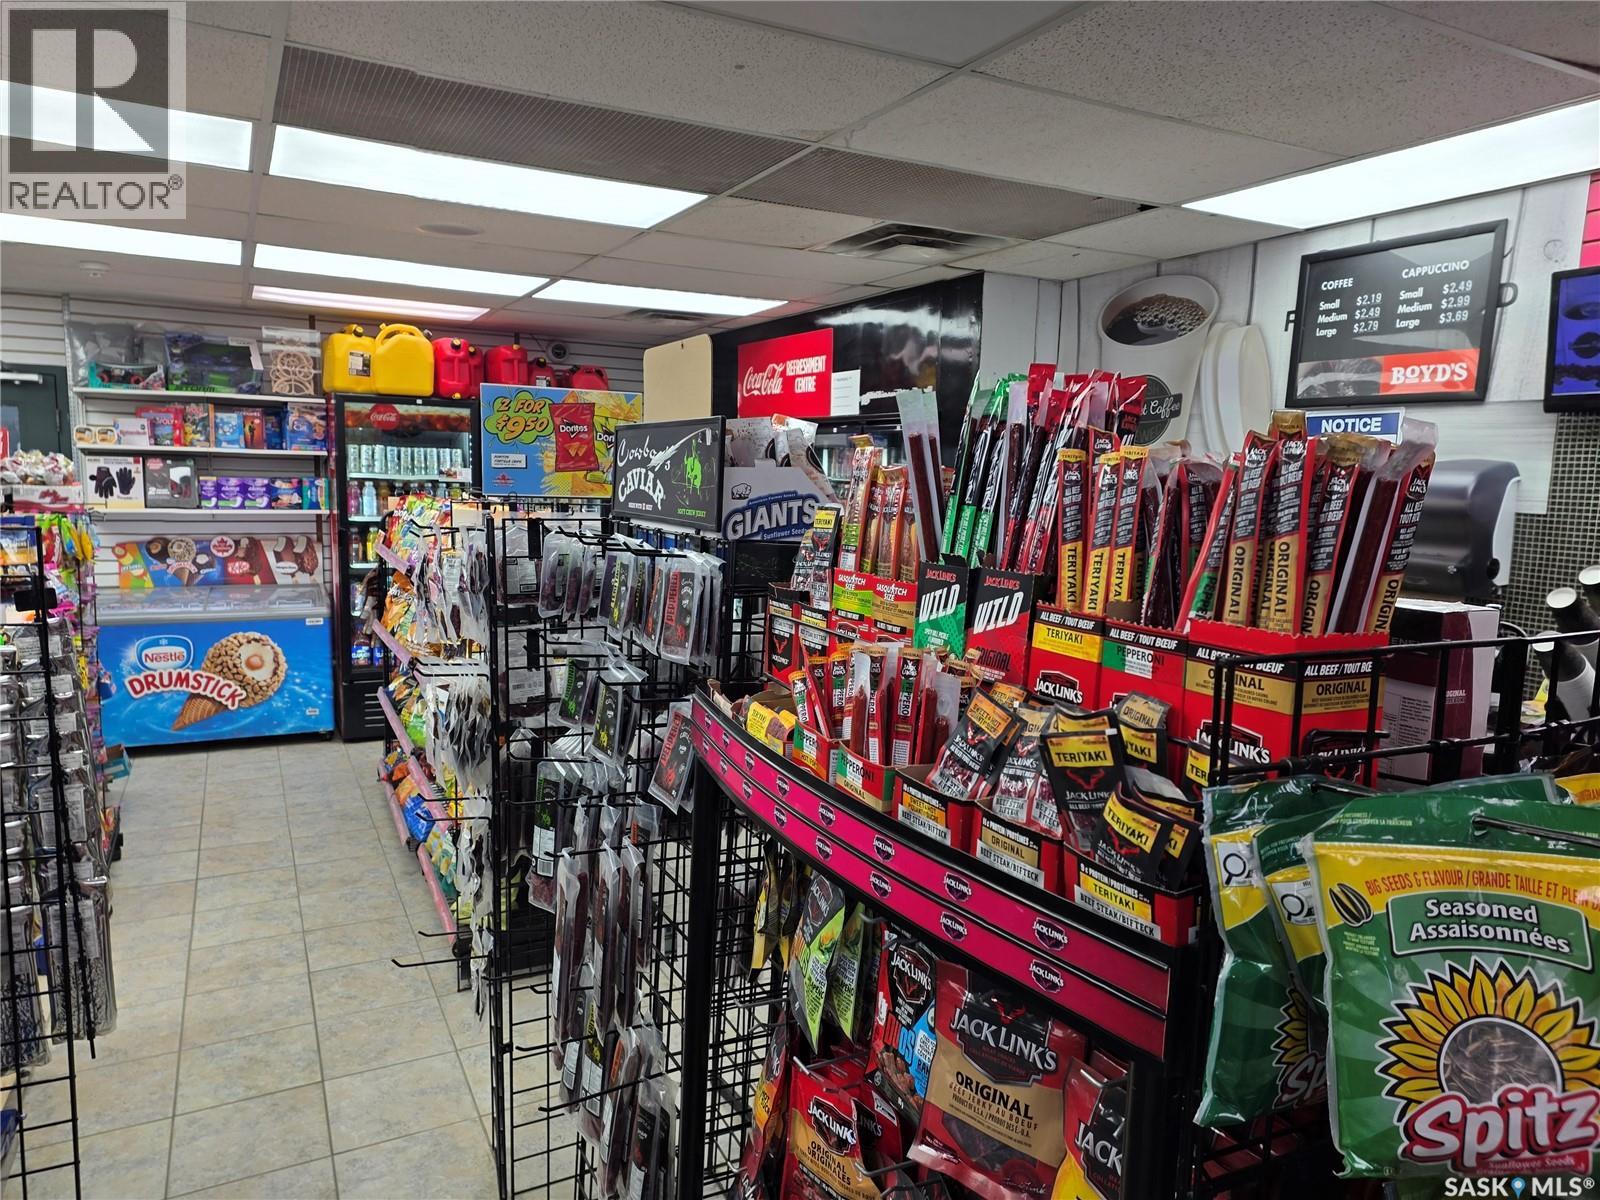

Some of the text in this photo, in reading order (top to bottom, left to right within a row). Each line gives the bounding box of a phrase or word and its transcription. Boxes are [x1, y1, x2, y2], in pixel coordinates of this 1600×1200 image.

[1402, 260, 1470, 279] CAPPUCCINO
[1321, 278, 1354, 291] COFFEE
[1399, 280, 1473, 300] Small $2.49
[1319, 293, 1382, 311] Small $2.19
[1397, 295, 1470, 314] Medium $2.99
[1317, 306, 1381, 323] Medium $2.49
[1395, 310, 1469, 329] Large $3.69
[1316, 320, 1379, 338] Large $2.79
[786, 355, 827, 376] REFRESHMENT
[1390, 362, 1469, 385] BOYD'S
[795, 376, 816, 393] CENTRE
[497, 399, 546, 414] 2 FOR
[1150, 396, 1180, 419] Coffee
[559, 423, 588, 434] Doritos
[1321, 416, 1382, 433] NOTICE
[618, 467, 664, 510] CAVIAR
[1412, 478, 1426, 487] JACK
[1405, 503, 1414, 513] ALL
[726, 497, 818, 541] GIANTS
[763, 530, 790, 540] Sunflower
[1066, 546, 1077, 605] TERIYAKI
[1087, 552, 1104, 611] TERIYAKI
[1112, 552, 1126, 600] TERIYA
[1229, 545, 1246, 617] ORIGINAL
[1275, 540, 1290, 617] ORIGINAL
[876, 583, 907, 596] SASQUATCH
[919, 584, 960, 623] WILD
[973, 591, 1025, 635] WILD
[1040, 611, 1049, 621] ALL
[1049, 613, 1061, 624] BEEF
[1065, 614, 1077, 625] TOUT
[1046, 627, 1083, 645] TERIYAKI
[1109, 628, 1120, 638] ALL
[1120, 629, 1135, 641] BEEF
[1139, 633, 1155, 646] TOUT
[144, 650, 185, 663] Nestlé
[1117, 645, 1165, 666] PEPPERONI
[1196, 647, 1209, 660] ALL
[1304, 665, 1318, 676] ALL
[1319, 663, 1338, 675] BEEF
[1344, 662, 1360, 674] TOUT
[128, 671, 244, 707] DRUMSTICK
[1034, 678, 1083, 704] JACK LINK'S
[1316, 681, 1367, 696] ORIGINAL
[1123, 705, 1154, 727] ORIGINAL
[842, 751, 875, 783] PEPPERONI
[1056, 751, 1107, 763] TERIYAKI
[843, 779, 866, 800] ORIGINAL
[1065, 792, 1088, 801] JACK
[1107, 806, 1149, 846] TERIYAKI
[980, 847, 992, 859] BEEF
[991, 835, 1024, 859] ORIGINAL
[943, 876, 957, 890] JACK
[1365, 880, 1381, 897] BIG
[1381, 873, 1412, 893] SEEDS
[1423, 869, 1463, 887] FLAVOUR
[1472, 872, 1511, 889] GRANDE
[1513, 874, 1543, 894] TAILLE
[1546, 881, 1558, 899] ET
[1093, 883, 1135, 911] TERIYAKI
[1080, 892, 1155, 936] BEEF STEAK/BIFTECK
[1425, 899, 1538, 924] Seasoned
[940, 916, 952, 929] JACK
[1033, 921, 1048, 936] JACK
[1409, 920, 1570, 954] Assaisonnées
[891, 954, 932, 991] JACK LINK'S
[1029, 965, 1044, 979] JACK
[951, 1007, 1057, 1071] JACK LINK'S
[955, 1071, 1034, 1120] ORIGINAL
[808, 1101, 830, 1127] JACK
[968, 1089, 993, 1111] JERKY
[995, 1105, 1006, 1118] AU
[1009, 1114, 1038, 1131] BOEUF
[1412, 1091, 1597, 1168] Spitz
[810, 1141, 847, 1174] ORIGINAL
[1075, 1121, 1123, 1177] JACK
[807, 1147, 851, 1186] ORIGINALES
